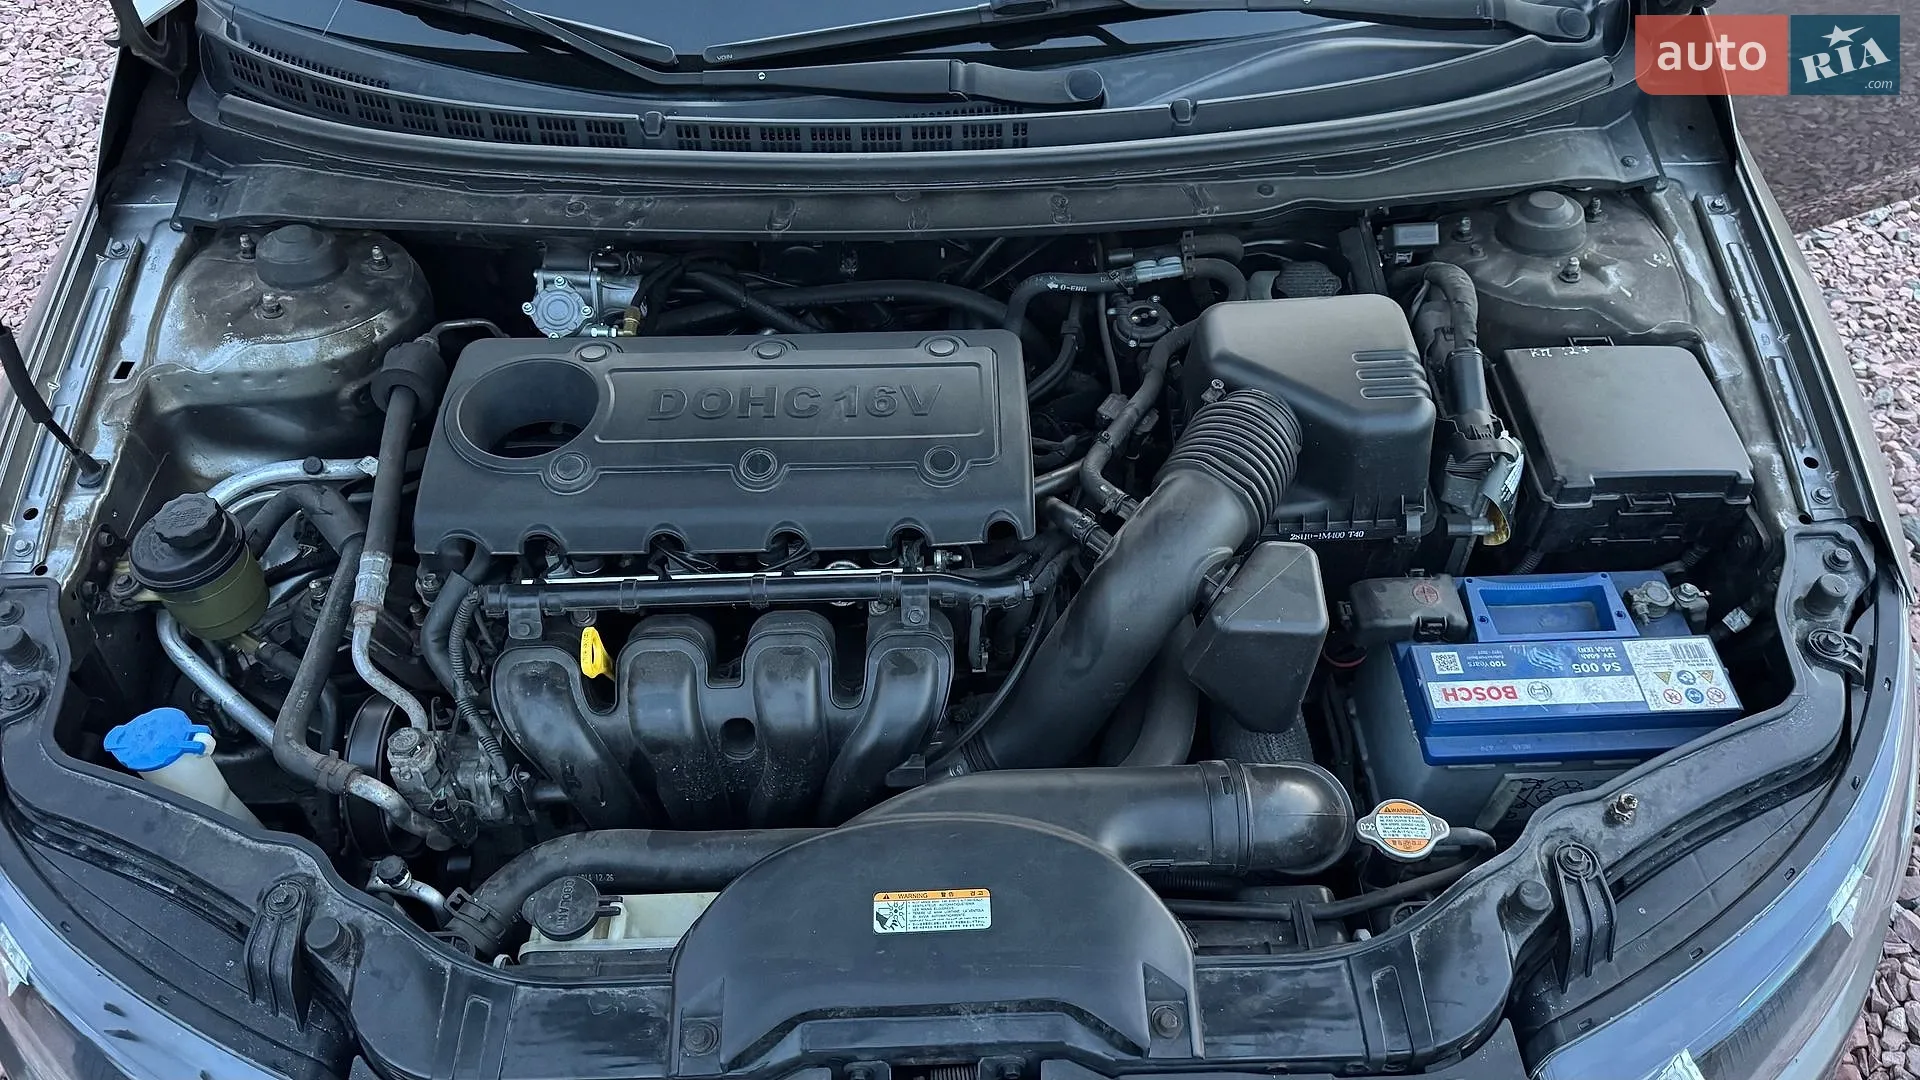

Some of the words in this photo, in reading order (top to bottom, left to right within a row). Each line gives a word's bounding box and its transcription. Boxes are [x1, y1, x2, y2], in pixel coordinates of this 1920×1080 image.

[648, 385, 823, 420] DOHC
[834, 383, 942, 418] 16V
[1571, 662, 1600, 674] 005
[1601, 661, 1622, 673] S4
[1441, 685, 1519, 702] BOSCH
